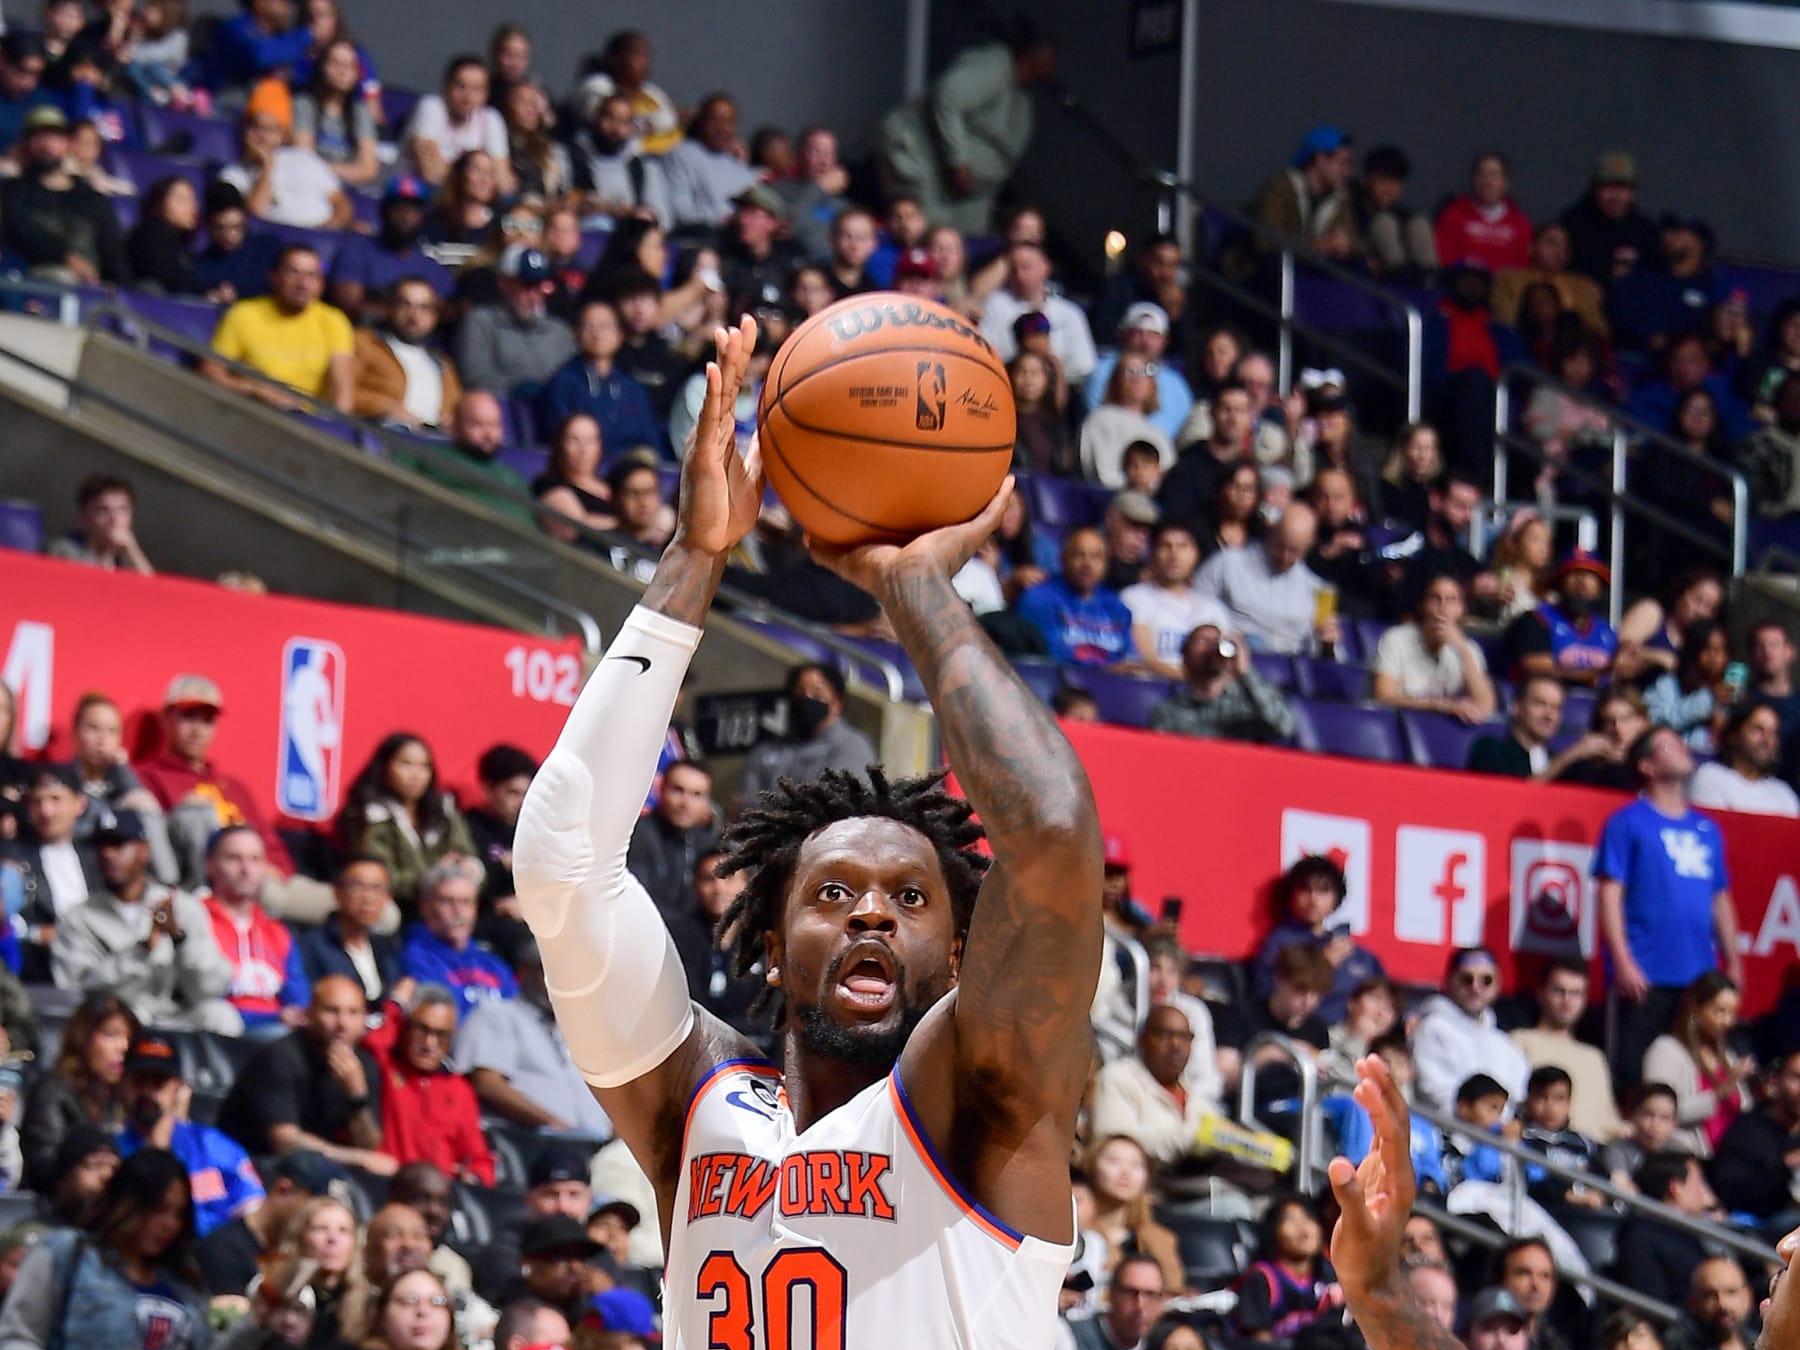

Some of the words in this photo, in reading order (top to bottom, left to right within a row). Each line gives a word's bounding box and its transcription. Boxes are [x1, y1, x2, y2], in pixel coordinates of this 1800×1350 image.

[830, 303, 993, 354] Wilson
[504, 646, 580, 706] 102
[688, 1151, 779, 1222] NEW
[779, 1149, 897, 1224] ORK
